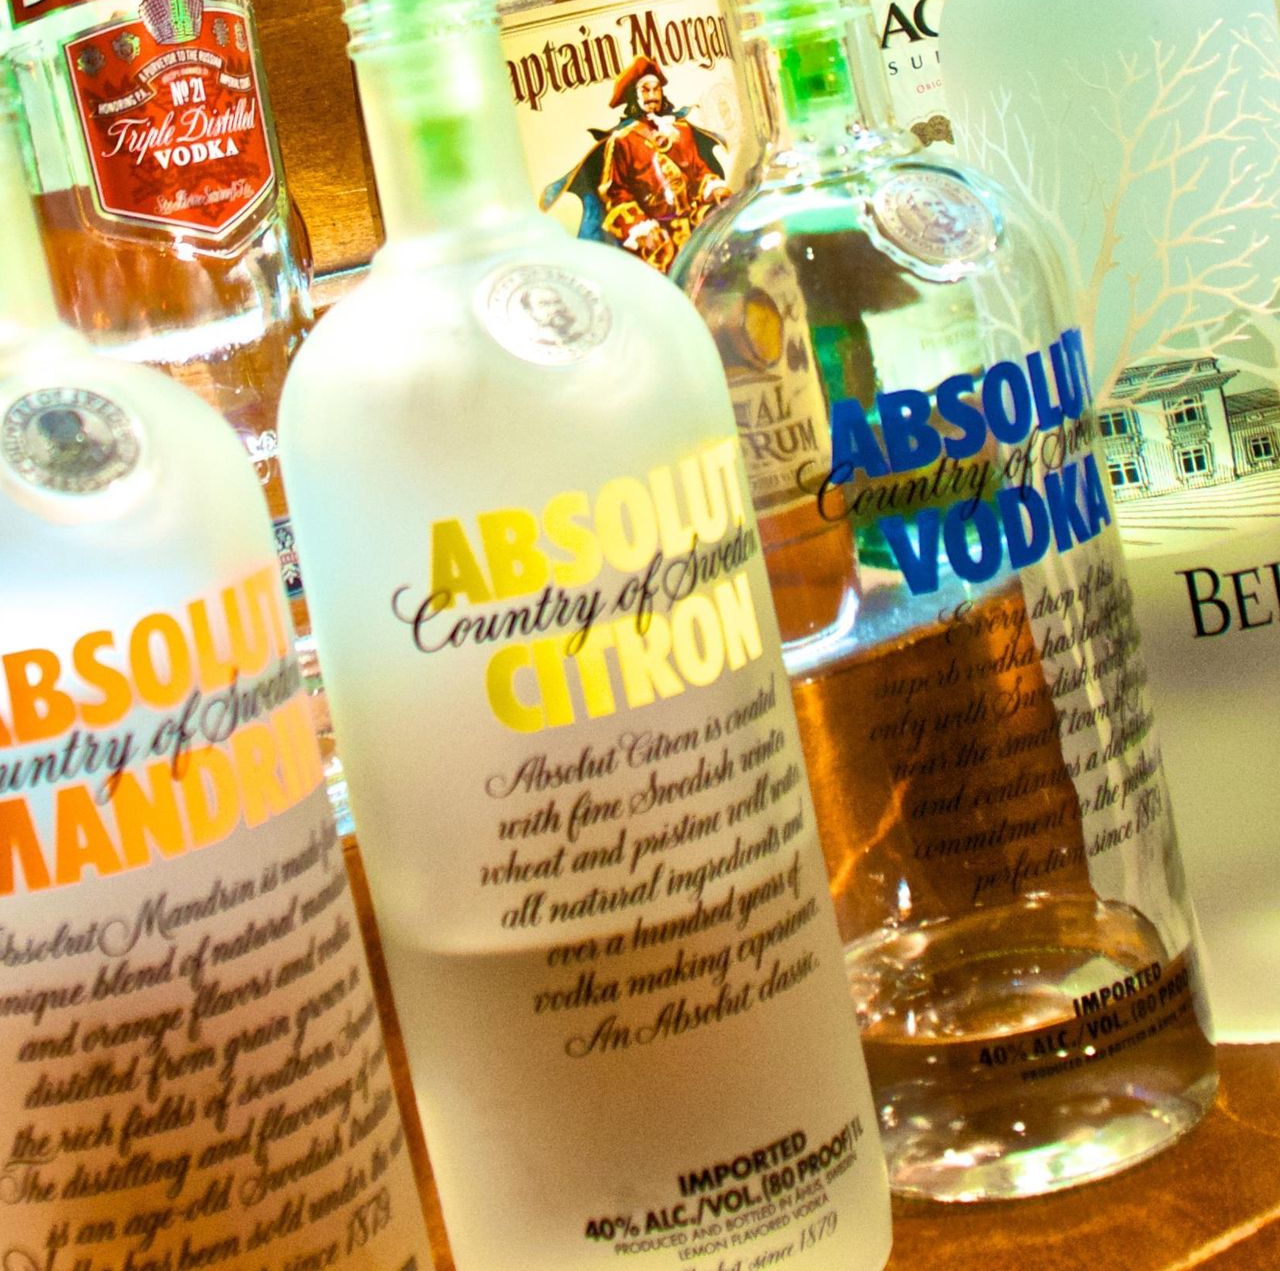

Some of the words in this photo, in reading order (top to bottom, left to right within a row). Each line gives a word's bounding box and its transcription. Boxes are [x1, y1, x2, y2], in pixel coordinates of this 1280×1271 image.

[190, 77, 206, 104] 21
[508, 24, 621, 111] aptain
[616, 9, 732, 75] Morgan
[101, 111, 176, 165] Triple
[176, 97, 256, 143] Distilled
[153, 137, 239, 170] VODKA
[739, 416, 820, 462] RUM
[429, 436, 748, 610] ABSOLUT
[796, 457, 991, 523] Country
[878, 453, 1112, 597] VODKA
[392, 583, 607, 656] Country
[617, 550, 666, 636] of
[662, 524, 759, 602] Sweden
[484, 569, 763, 734] CITRON
[150, 690, 202, 784] of
[485, 746, 619, 799] Absolut
[497, 804, 563, 843] with
[567, 791, 623, 844] fine
[629, 748, 735, 816] Swedish
[480, 848, 565, 887] wheat
[570, 829, 628, 873] and
[629, 809, 721, 873] pristine
[501, 894, 542, 930] all
[548, 865, 664, 924] natural
[665, 824, 782, 901] ingredients
[89, 952, 171, 1003] blend
[178, 938, 211, 992] of
[210, 901, 297, 967] natural
[99, 868, 258, 958] Mandrin
[545, 937, 600, 968] over
[604, 937, 624, 957] a
[630, 886, 736, 949] hundred
[18, 1029, 76, 1062] and
[80, 1006, 184, 1055] orange
[190, 971, 273, 1041] flavors
[274, 936, 316, 989] and
[533, 969, 622, 1016] vodka
[626, 941, 733, 998] making
[564, 1016, 632, 1059] An
[635, 980, 753, 1046] Absolut
[1073, 961, 1163, 1019] IMPORTED
[5, 1127, 59, 1172] the
[58, 1114, 115, 1152] rich
[118, 1093, 195, 1158] fields
[204, 1081, 232, 1133] of
[237, 1041, 335, 1107] southern
[23, 1058, 143, 1110] distilled
[141, 1041, 217, 1102] from
[220, 1013, 291, 1079] grain
[61, 1147, 194, 1201] distilling
[197, 1128, 253, 1168] and
[253, 1081, 354, 1168] flavoring
[74, 1213, 116, 1244] an
[237, 1127, 345, 1209] Swedish
[678, 1129, 808, 1198] IMPORTED
[177, 1235, 241, 1271] been
[246, 1193, 307, 1252] sold
[306, 1167, 367, 1223] under
[584, 1216, 640, 1242] 40%
[645, 1185, 763, 1235] ALC./VOL.
[762, 1164, 794, 1203] (80
[614, 1231, 688, 1257] PRODUCED
[692, 1220, 722, 1239] AND
[725, 1203, 777, 1233] BOTTLED
[677, 1239, 728, 1262] LEMON
[730, 1215, 790, 1249] FLAVORED
[791, 1192, 830, 1227] VODKA
